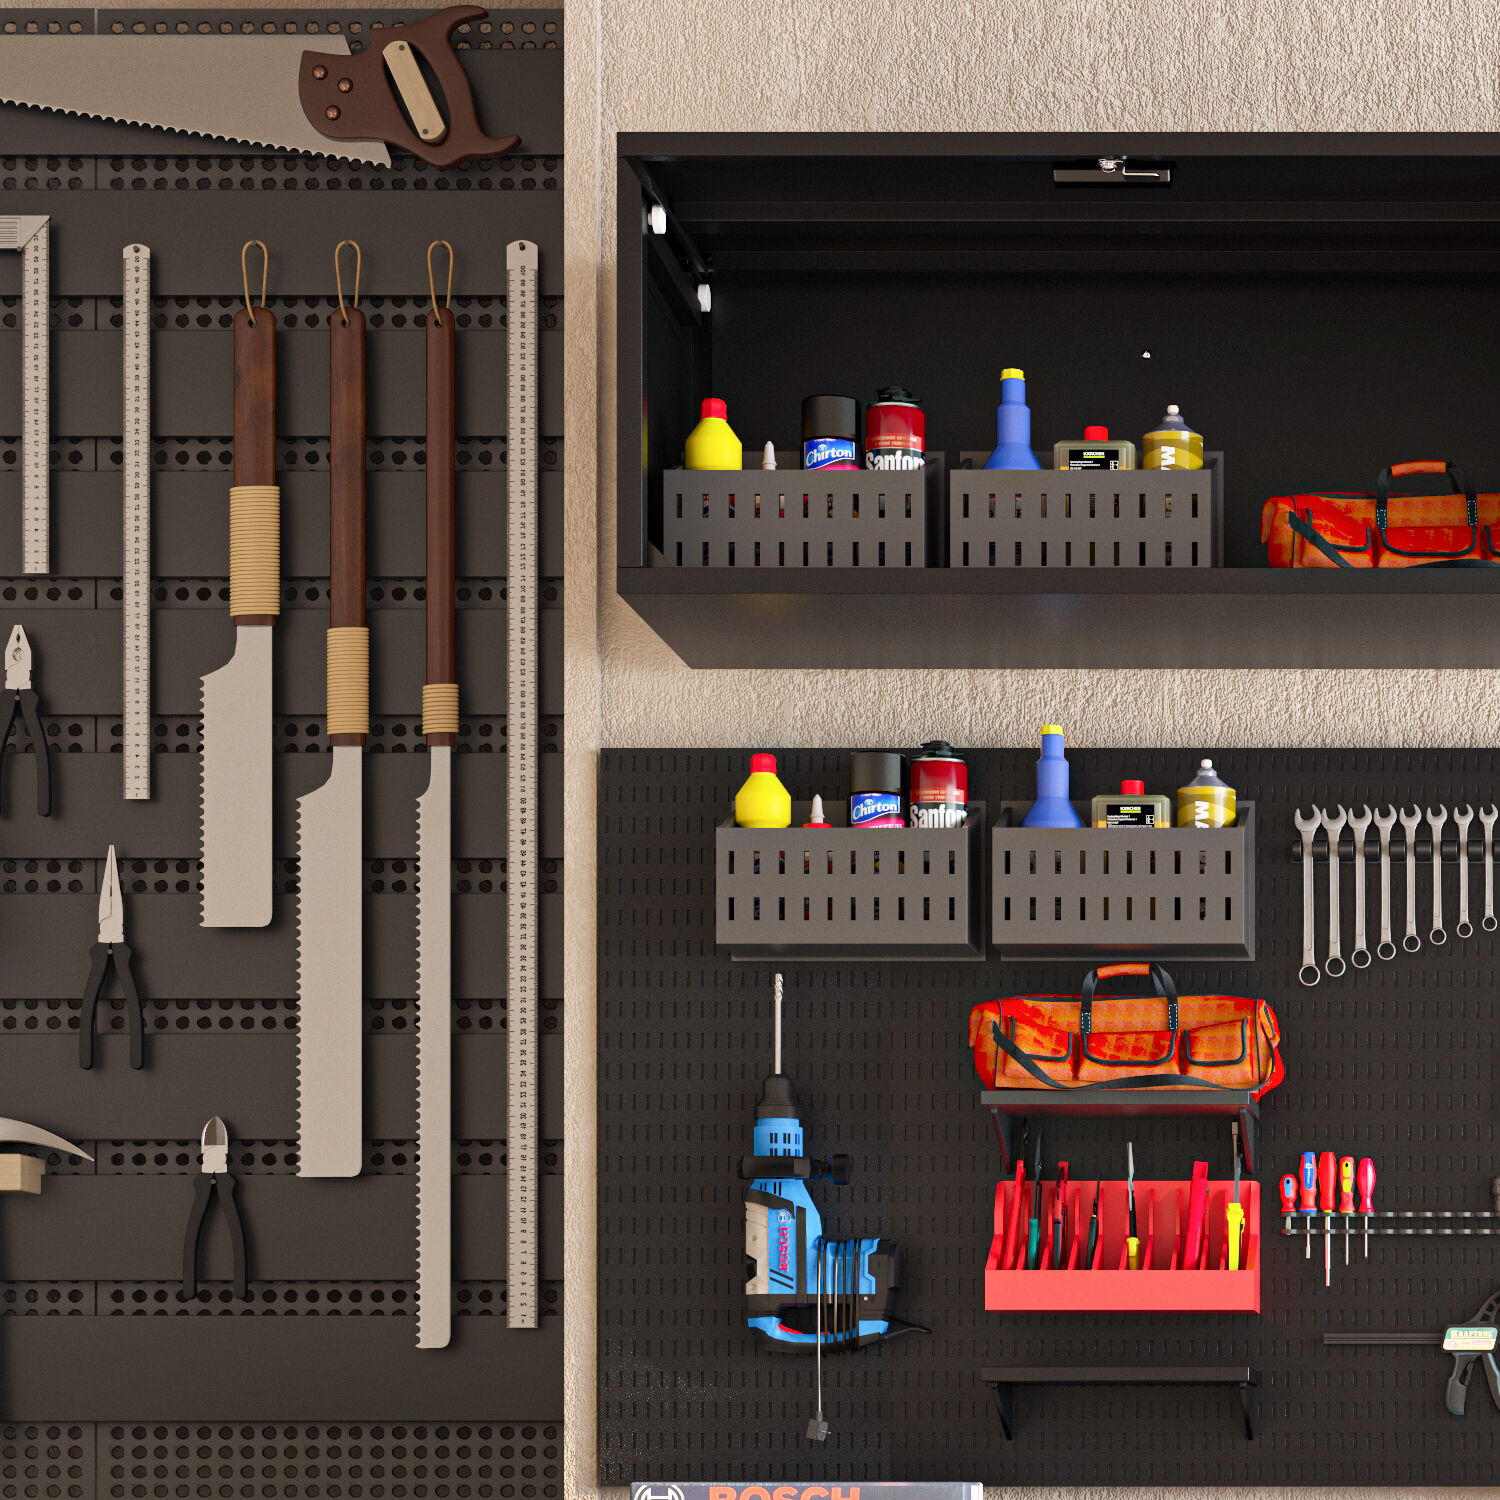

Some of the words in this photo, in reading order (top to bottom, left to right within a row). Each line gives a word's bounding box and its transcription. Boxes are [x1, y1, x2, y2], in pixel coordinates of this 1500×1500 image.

[806, 448, 853, 466] Chirton
[853, 802, 898, 820] Chirton
[779, 1228, 789, 1270] BOSCH
